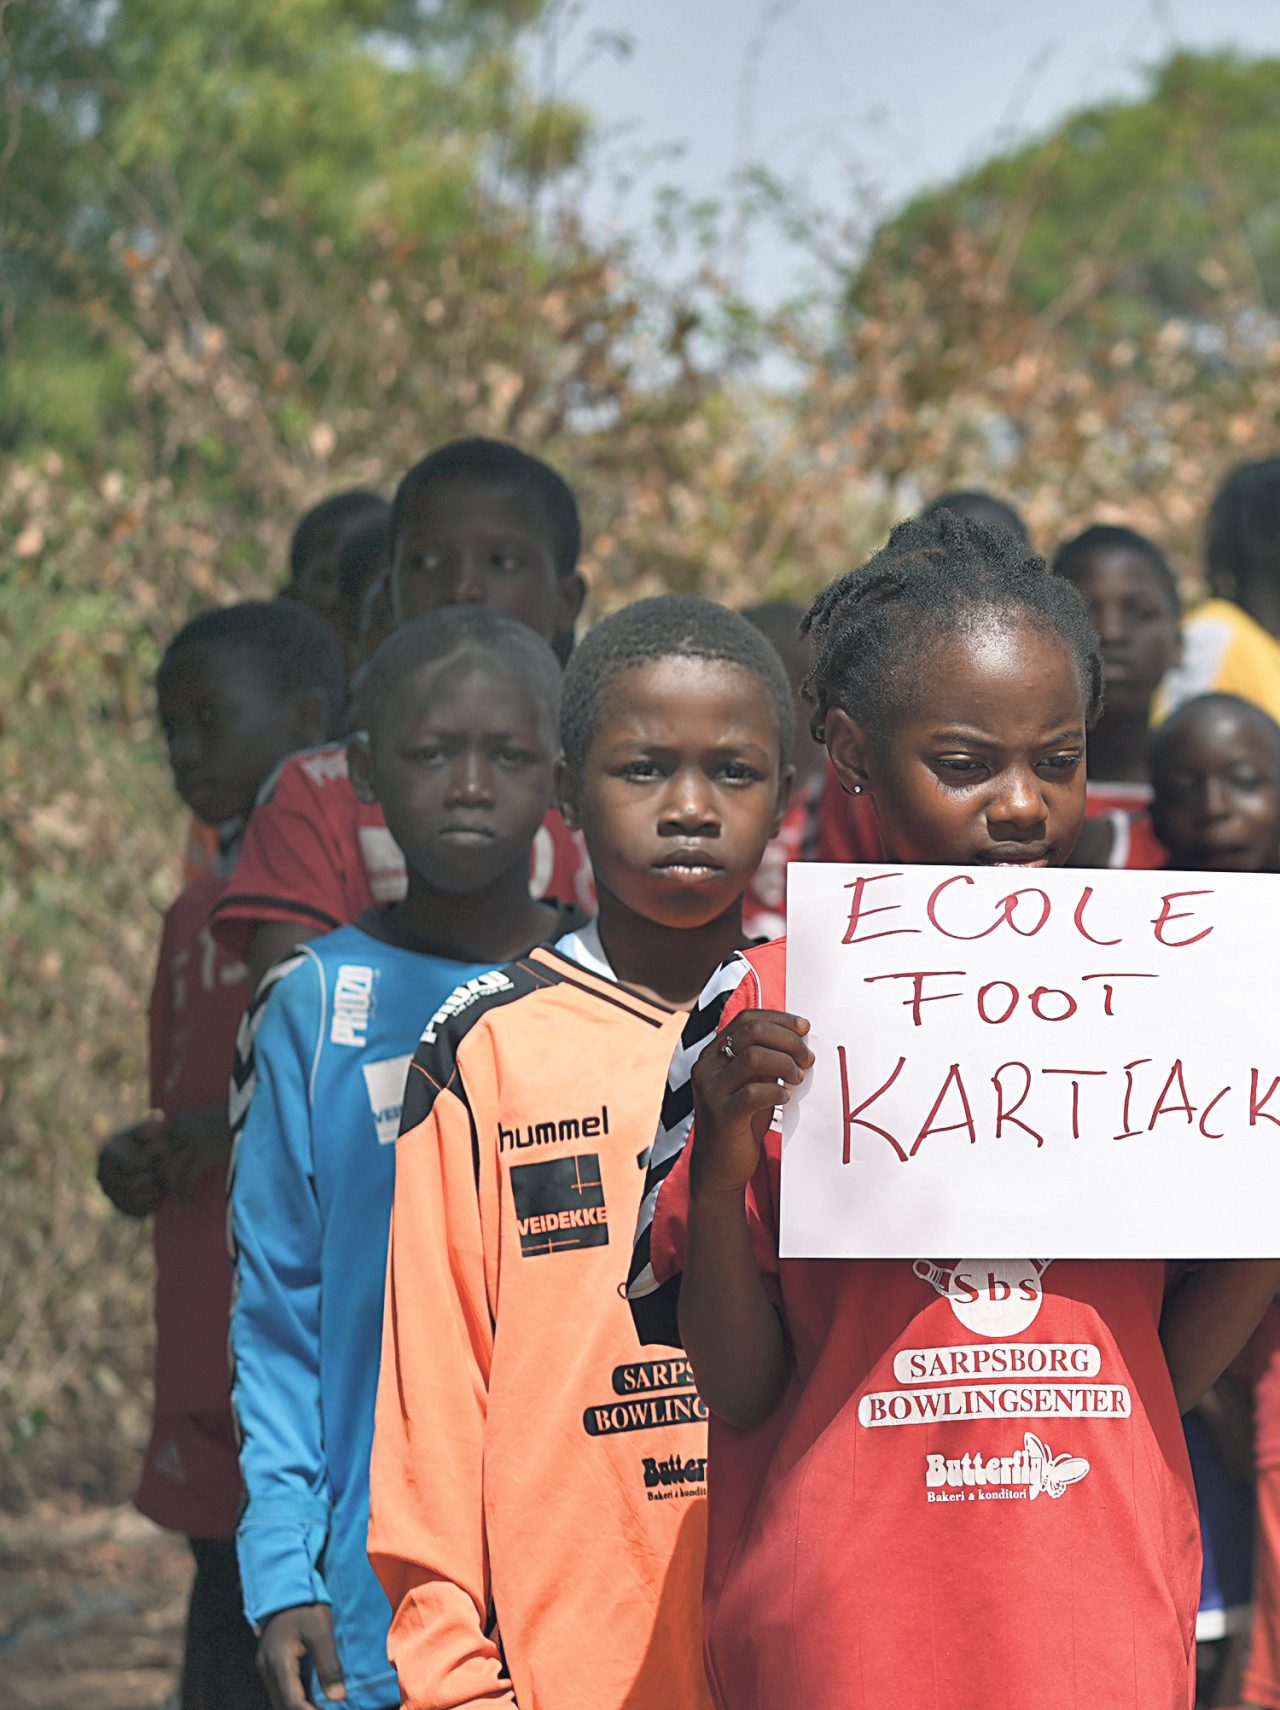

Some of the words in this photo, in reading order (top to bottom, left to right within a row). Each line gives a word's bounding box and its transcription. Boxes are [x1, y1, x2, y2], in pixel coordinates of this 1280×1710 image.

[841, 872, 1215, 947] ECOLE
[863, 970, 1160, 1026] FOOT
[497, 1105, 609, 1152] hummel
[517, 1207, 608, 1236] VEIDEKKE
[954, 1272, 1038, 1304] Sbs
[910, 1348, 1089, 1378] SARPSBORG
[870, 1389, 1126, 1422] BOWLINGSENTER
[641, 1454, 708, 1488] Butter
[926, 1450, 1045, 1493] Butterfly
[927, 1491, 965, 1503] Bakeri
[968, 1492, 975, 1501] &
[978, 1488, 1027, 1501] konditori
